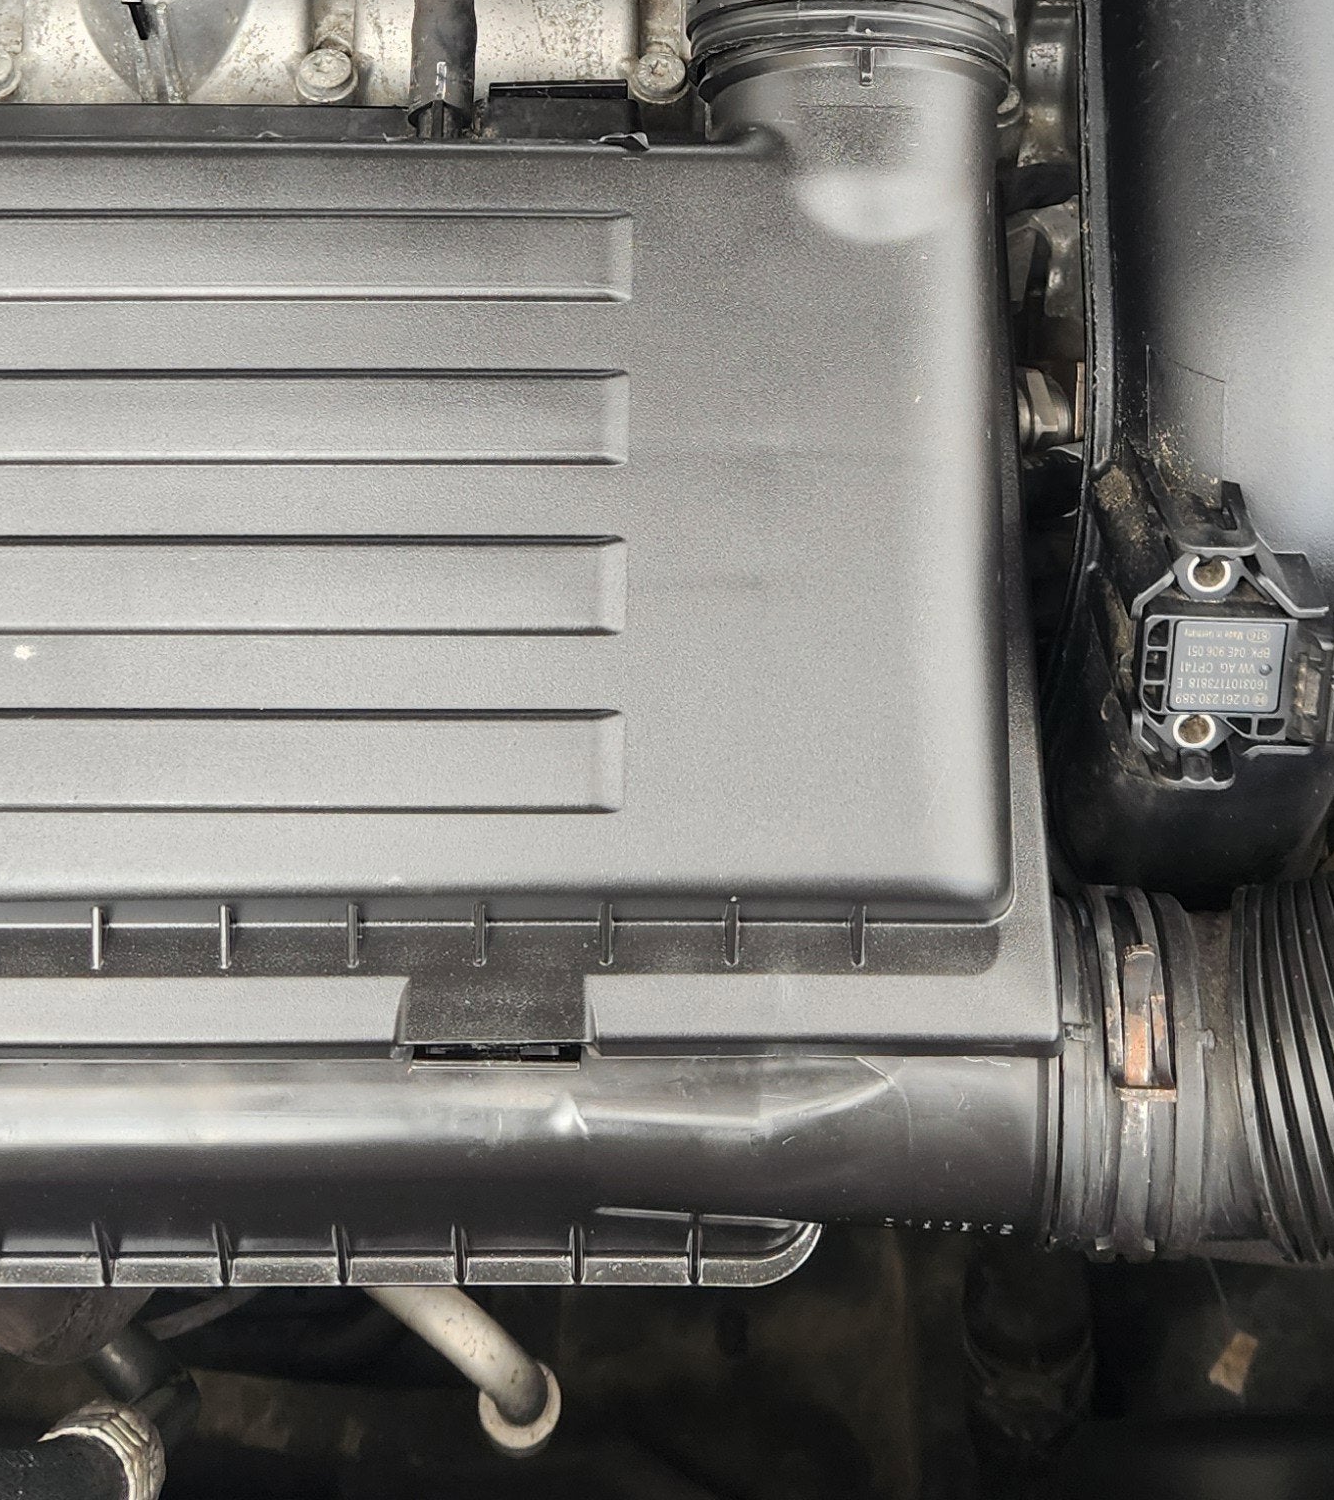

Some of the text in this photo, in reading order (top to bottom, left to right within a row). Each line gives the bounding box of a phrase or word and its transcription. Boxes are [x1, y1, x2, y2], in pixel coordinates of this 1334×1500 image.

[1187, 645, 1204, 657] 051
[1207, 645, 1225, 657] 906
[1227, 646, 1246, 658] 04E
[1220, 662, 1236, 673] AG
[1237, 662, 1256, 675] VW
[1198, 693, 1219, 705] 230
[1221, 693, 1241, 705] 261
